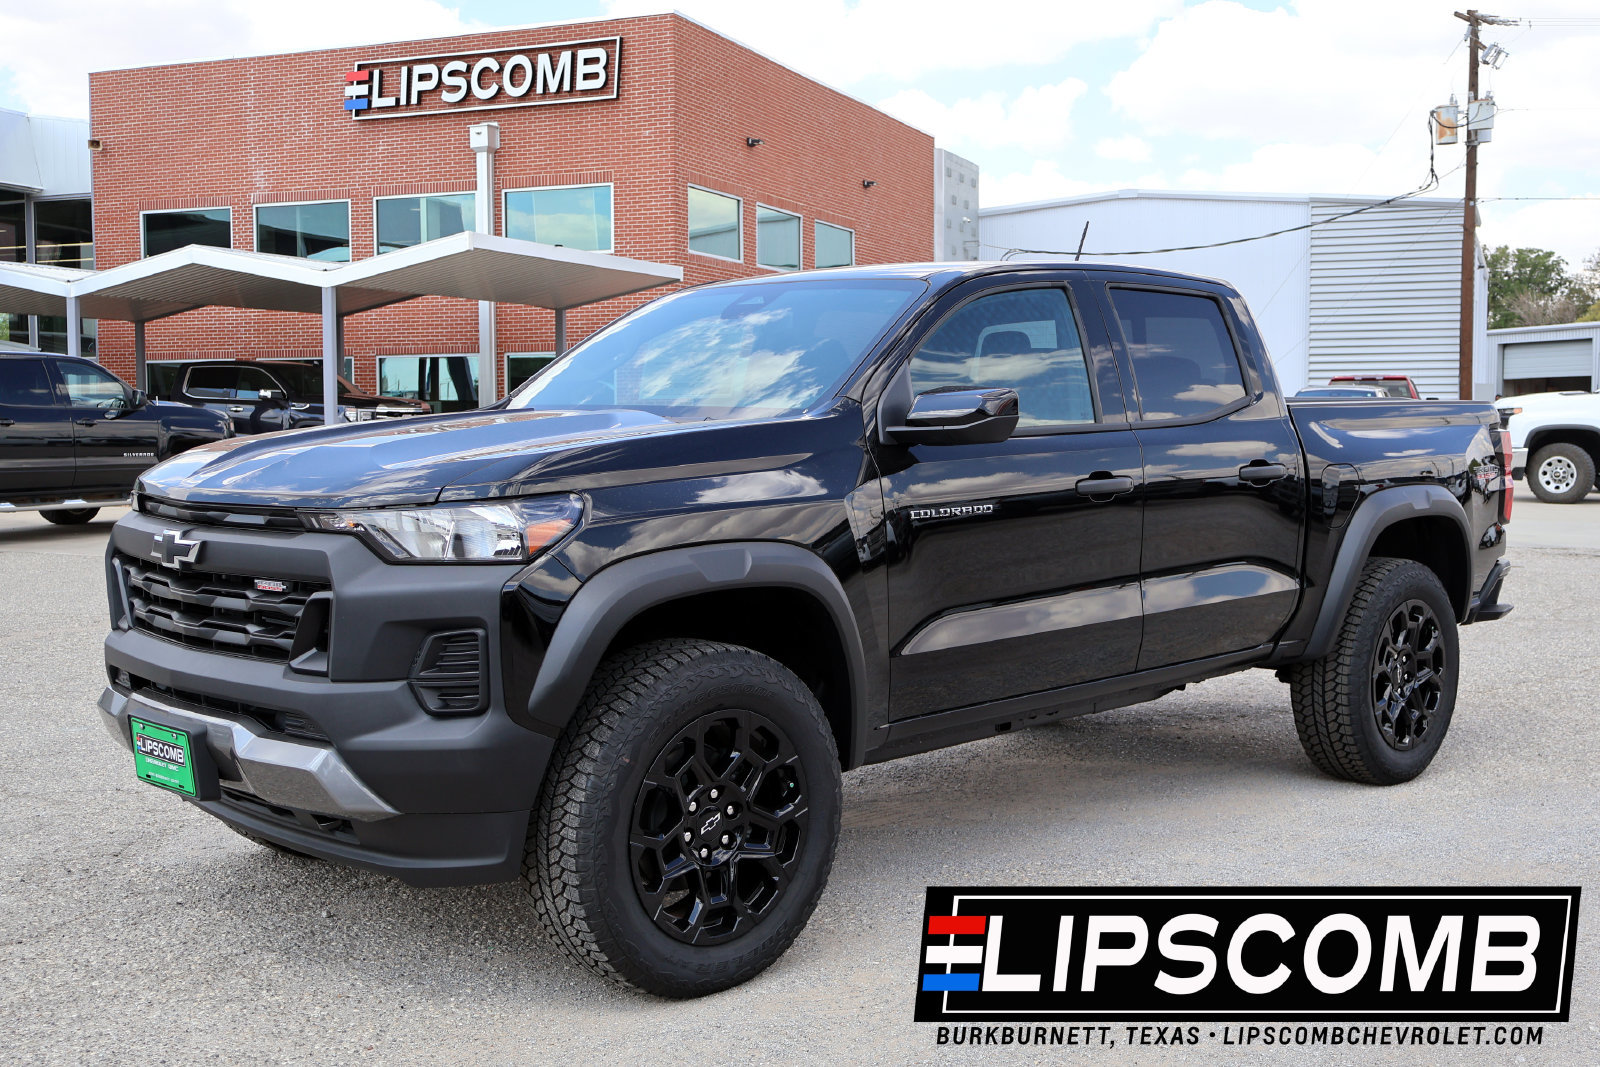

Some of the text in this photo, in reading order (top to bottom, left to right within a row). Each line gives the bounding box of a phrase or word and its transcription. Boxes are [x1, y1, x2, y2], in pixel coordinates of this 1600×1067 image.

[371, 47, 608, 108] LIPSCOMB
[910, 504, 993, 519] COLORADO
[140, 737, 184, 763] LIPSCOMB
